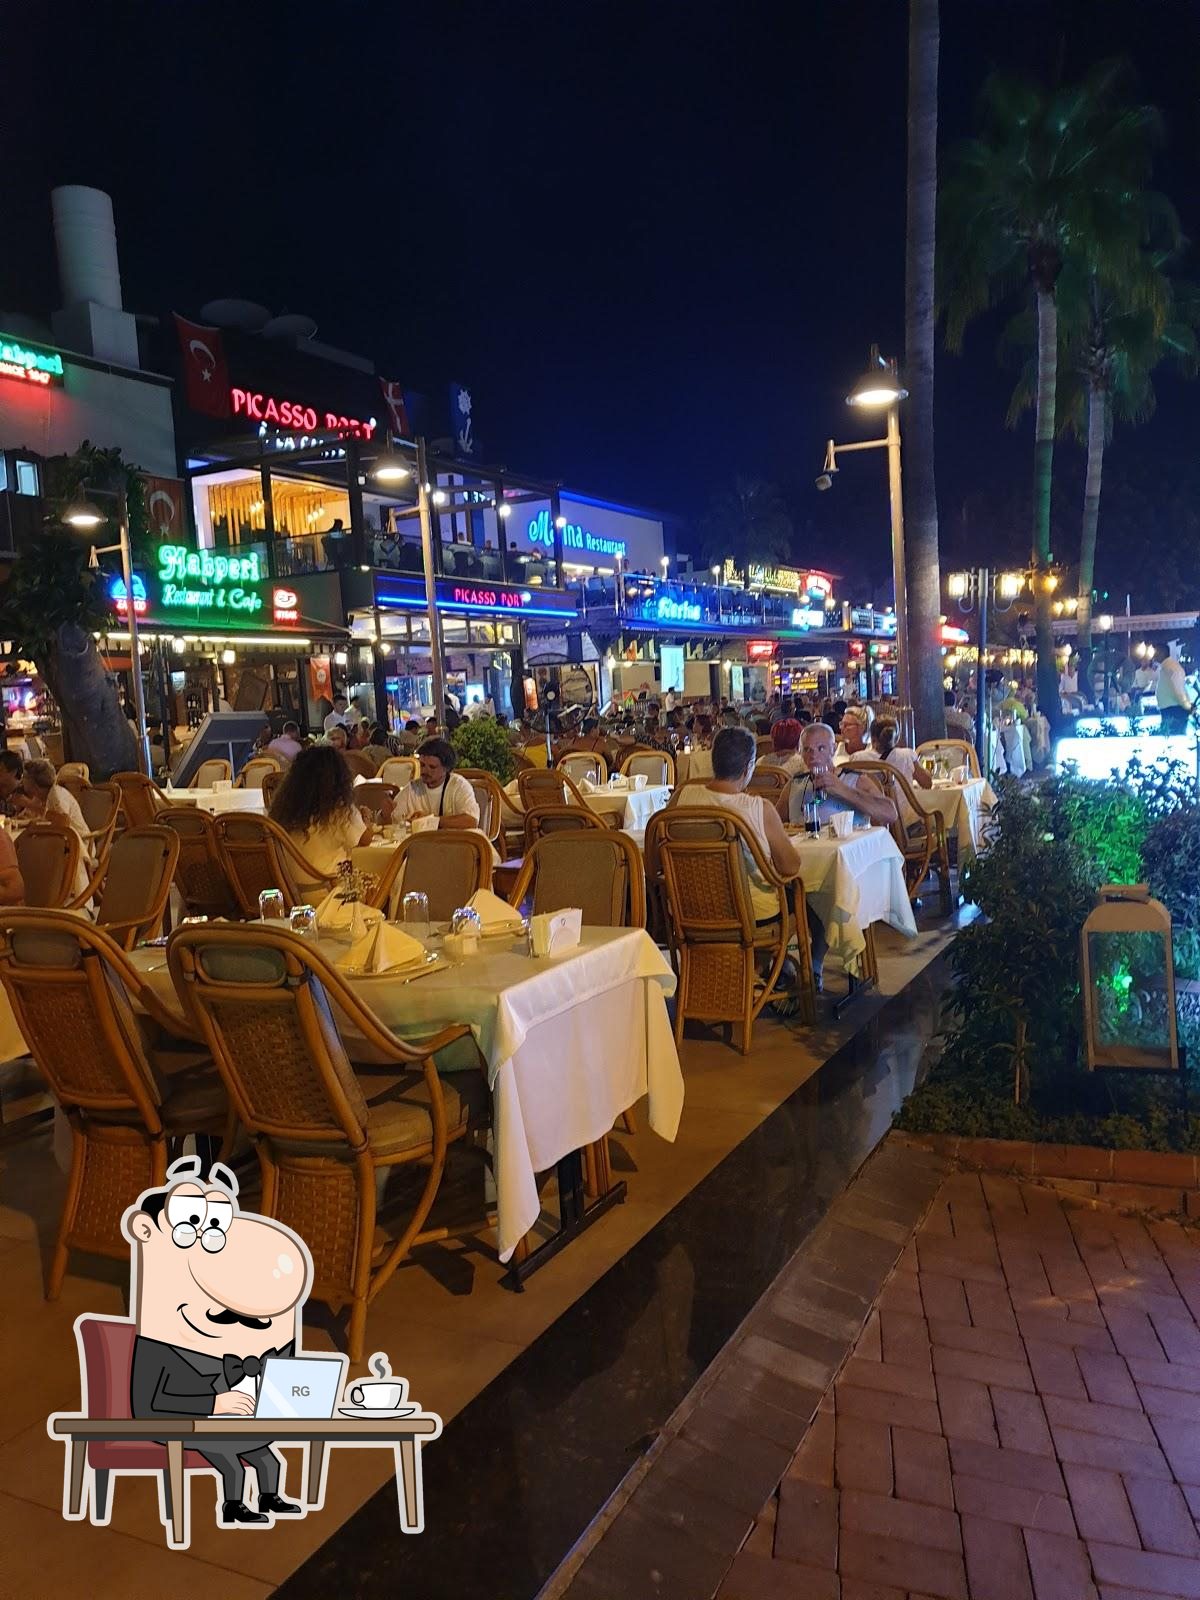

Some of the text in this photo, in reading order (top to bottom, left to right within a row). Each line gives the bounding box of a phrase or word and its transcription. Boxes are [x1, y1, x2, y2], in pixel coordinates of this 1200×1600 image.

[232, 388, 317, 430] PICASSO
[586, 532, 625, 556] Restaurant
[162, 584, 214, 606] Restaurant
[455, 588, 525, 608] PICASSO PORT
